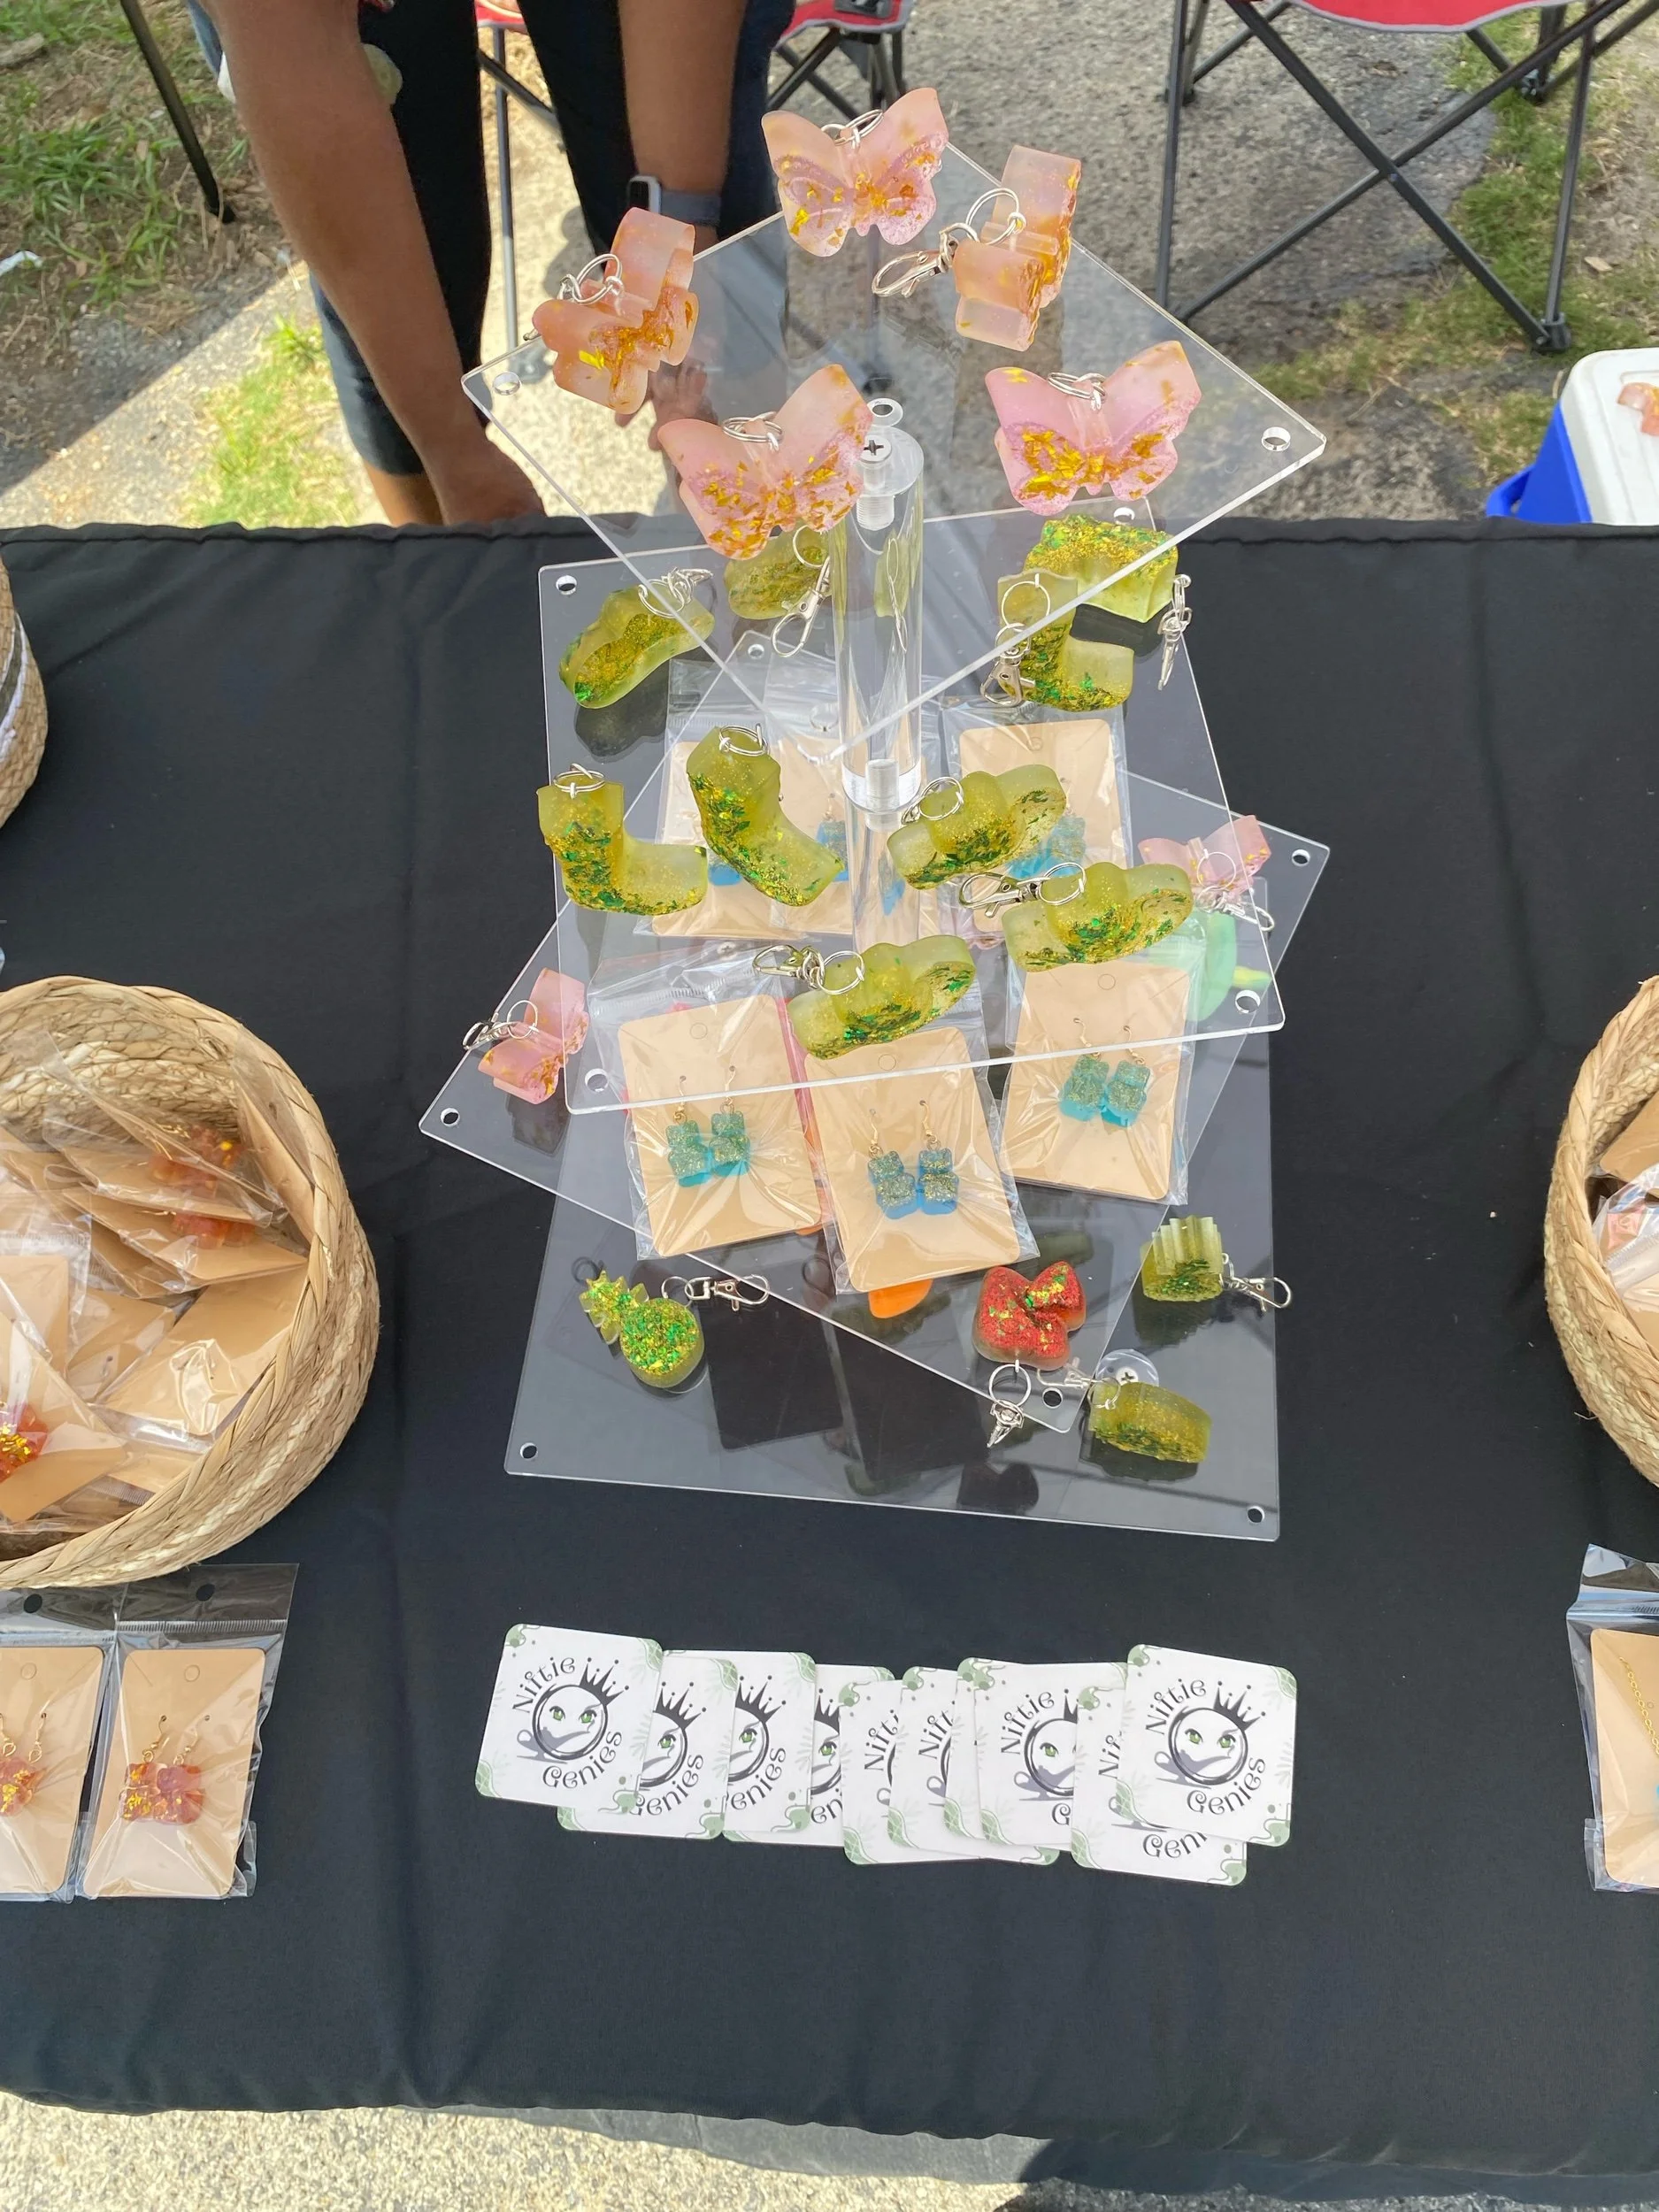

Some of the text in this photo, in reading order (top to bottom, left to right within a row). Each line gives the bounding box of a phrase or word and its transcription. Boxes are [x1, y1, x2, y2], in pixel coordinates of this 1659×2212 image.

[512, 1656, 576, 1714] Niftie
[1145, 1678, 1207, 1735] Niftie
[1000, 1691, 1055, 1755] Niftie
[542, 1731, 622, 1788] Genies
[726, 1747, 787, 1810] enies
[1187, 1757, 1265, 1815] Genies
